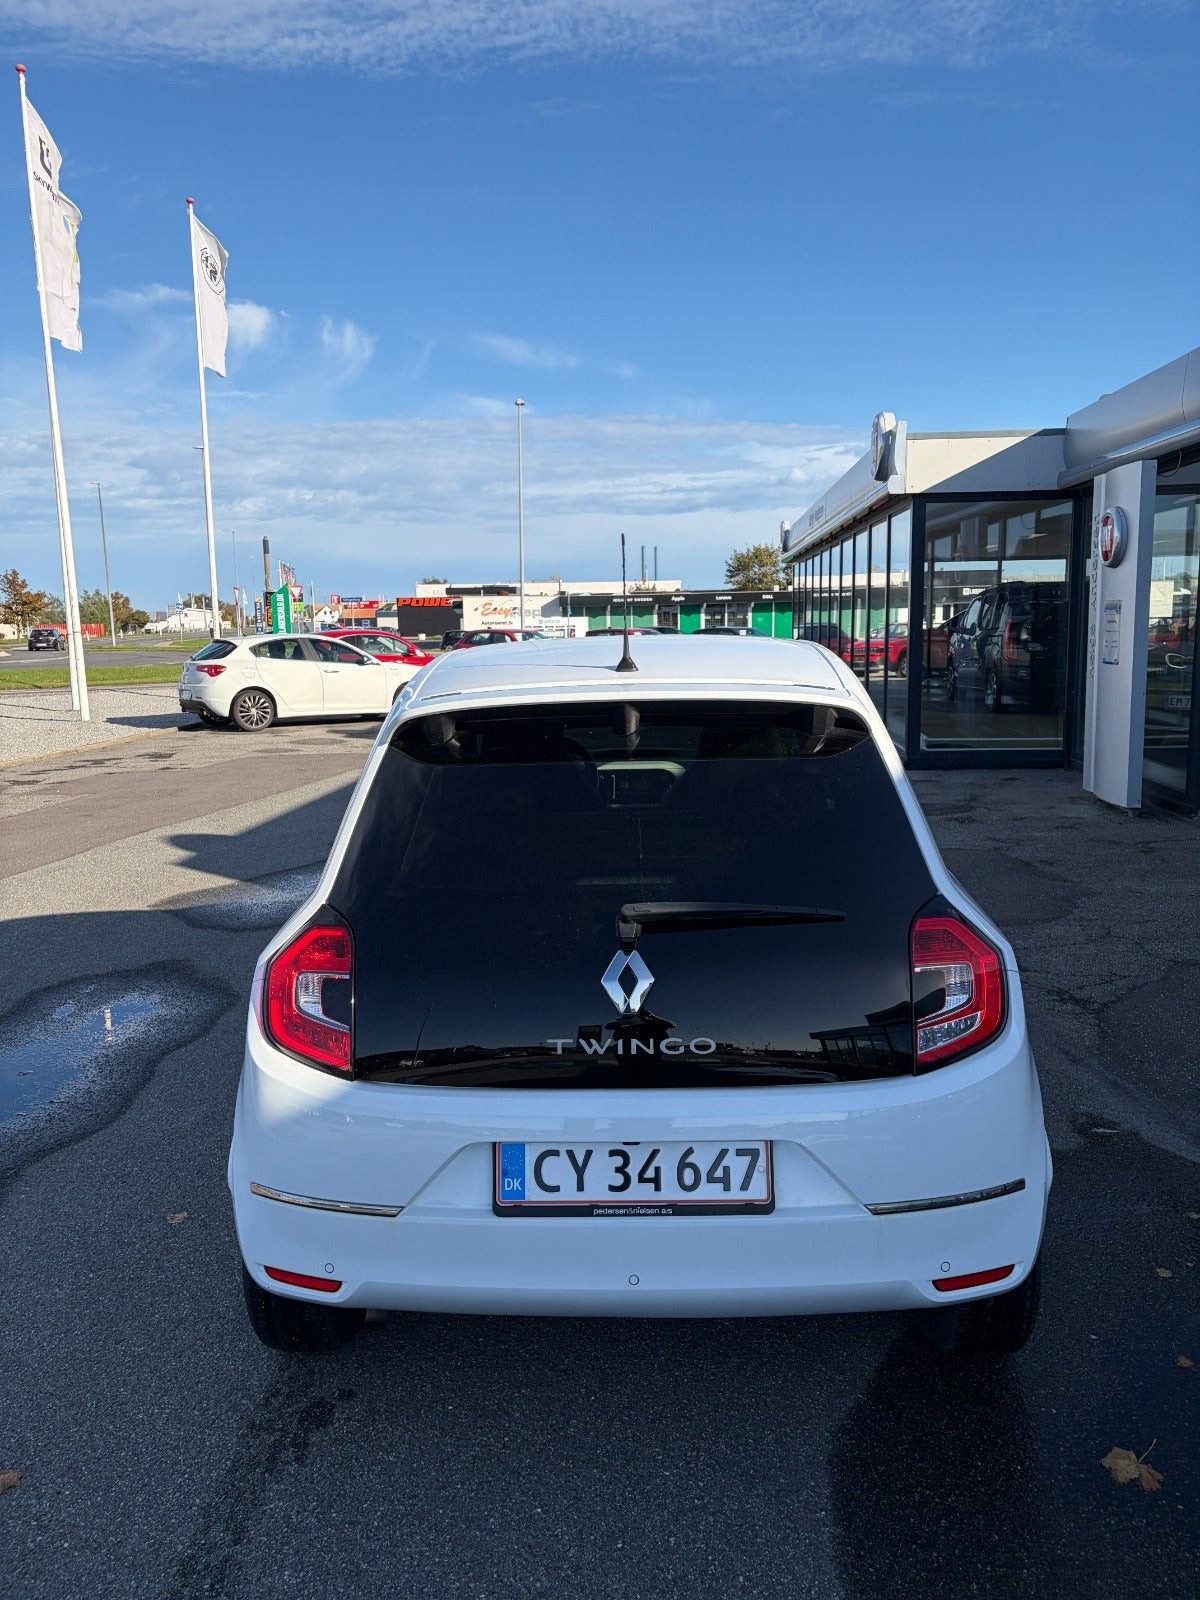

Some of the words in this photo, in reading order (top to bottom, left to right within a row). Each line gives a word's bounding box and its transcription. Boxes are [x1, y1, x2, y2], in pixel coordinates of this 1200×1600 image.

[398, 598, 459, 607] POWE
[547, 1038, 717, 1054] TWINGO
[533, 1149, 594, 1193] CY
[608, 1149, 662, 1193] 34
[676, 1146, 760, 1192] 647
[504, 1178, 522, 1191] DK
